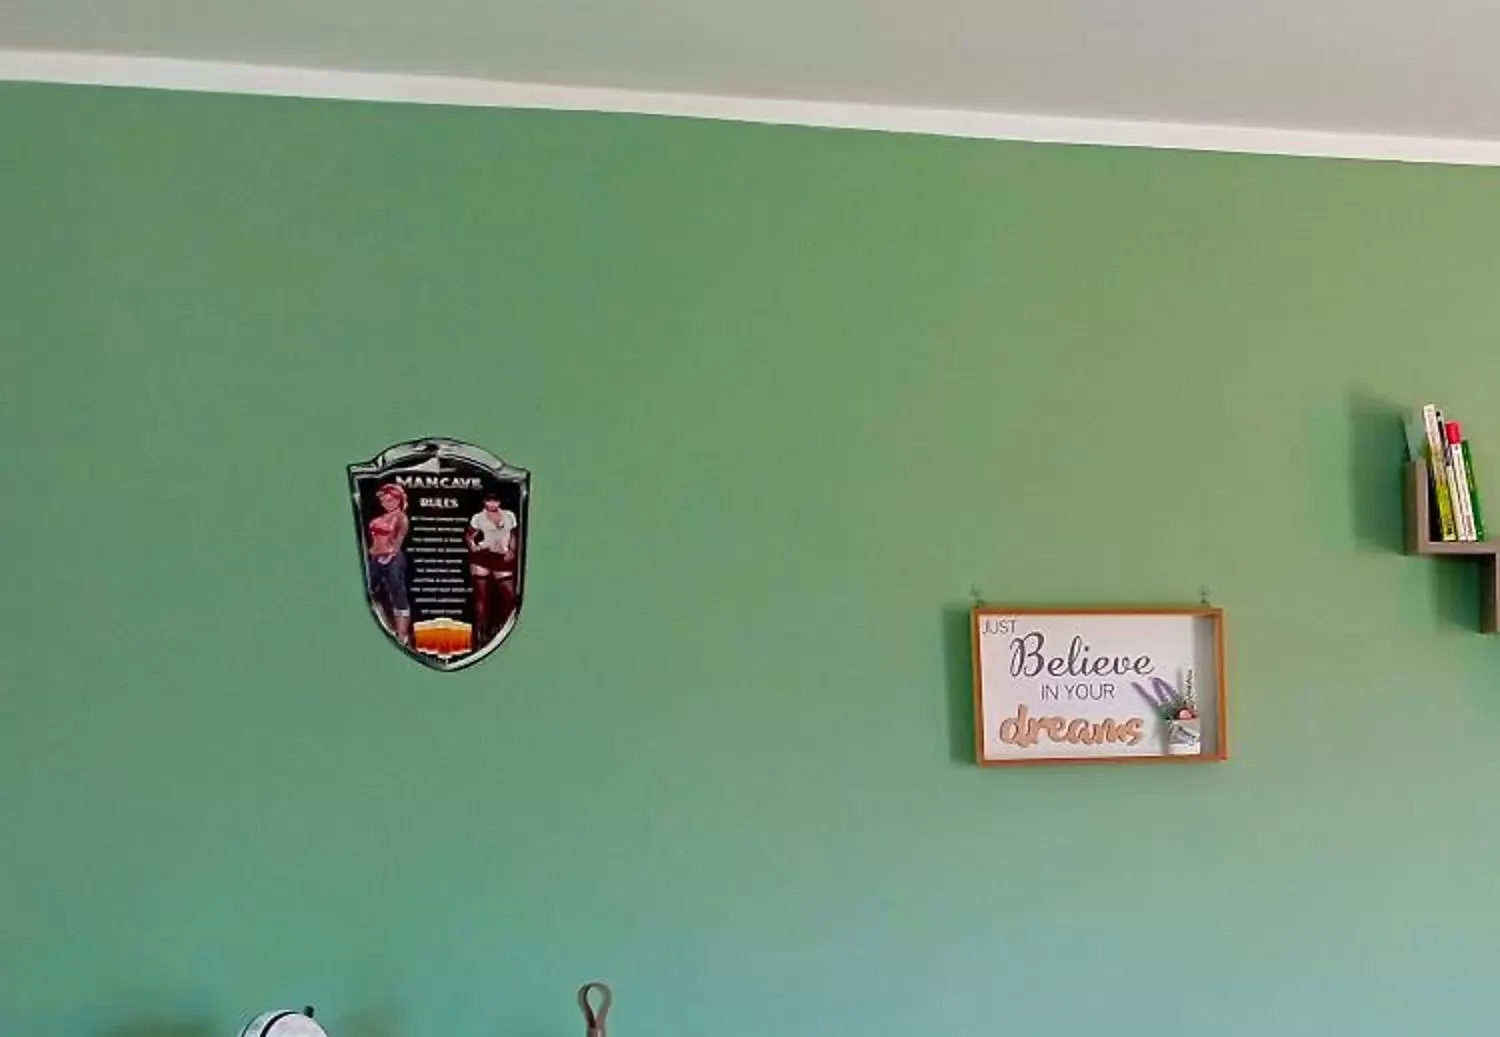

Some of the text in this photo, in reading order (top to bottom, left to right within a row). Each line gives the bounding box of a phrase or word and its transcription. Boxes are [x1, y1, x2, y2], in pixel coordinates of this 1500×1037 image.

[982, 619, 1018, 635] JUST
[1009, 631, 1156, 678] Believe
[1041, 683, 1116, 700] IN YOUR
[1000, 703, 1145, 748] dreams
